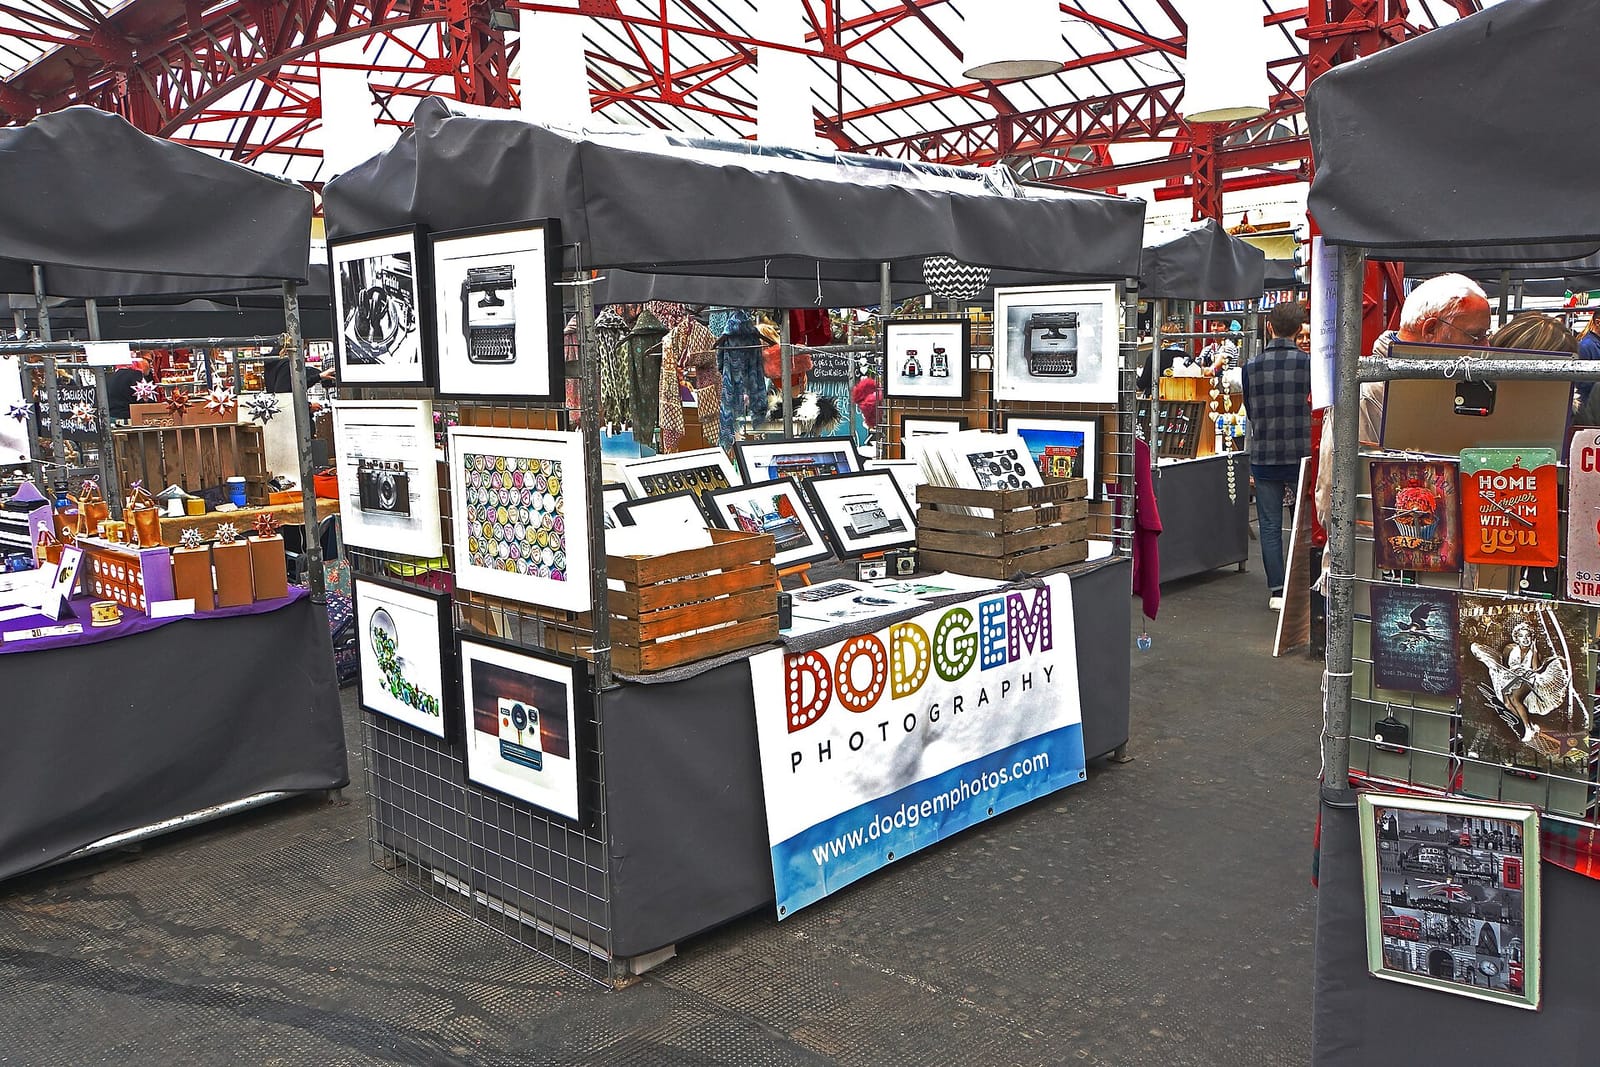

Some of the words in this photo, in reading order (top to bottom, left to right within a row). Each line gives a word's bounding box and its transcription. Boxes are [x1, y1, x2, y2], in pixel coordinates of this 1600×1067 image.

[1479, 476, 1537, 490] HOME
[1027, 484, 1069, 504] HOLLAND
[1035, 506, 1062, 524] FRUIT
[1518, 505, 1537, 516] I'M
[1480, 515, 1510, 526] WITH
[1393, 537, 1417, 548] EAT
[1480, 528, 1538, 553] you
[1573, 581, 1600, 597] STRA
[784, 584, 1054, 734] DODGEM
[790, 664, 1055, 773] PHOTOGRAPHY
[810, 750, 1050, 866] www.dodgemphotos.com
